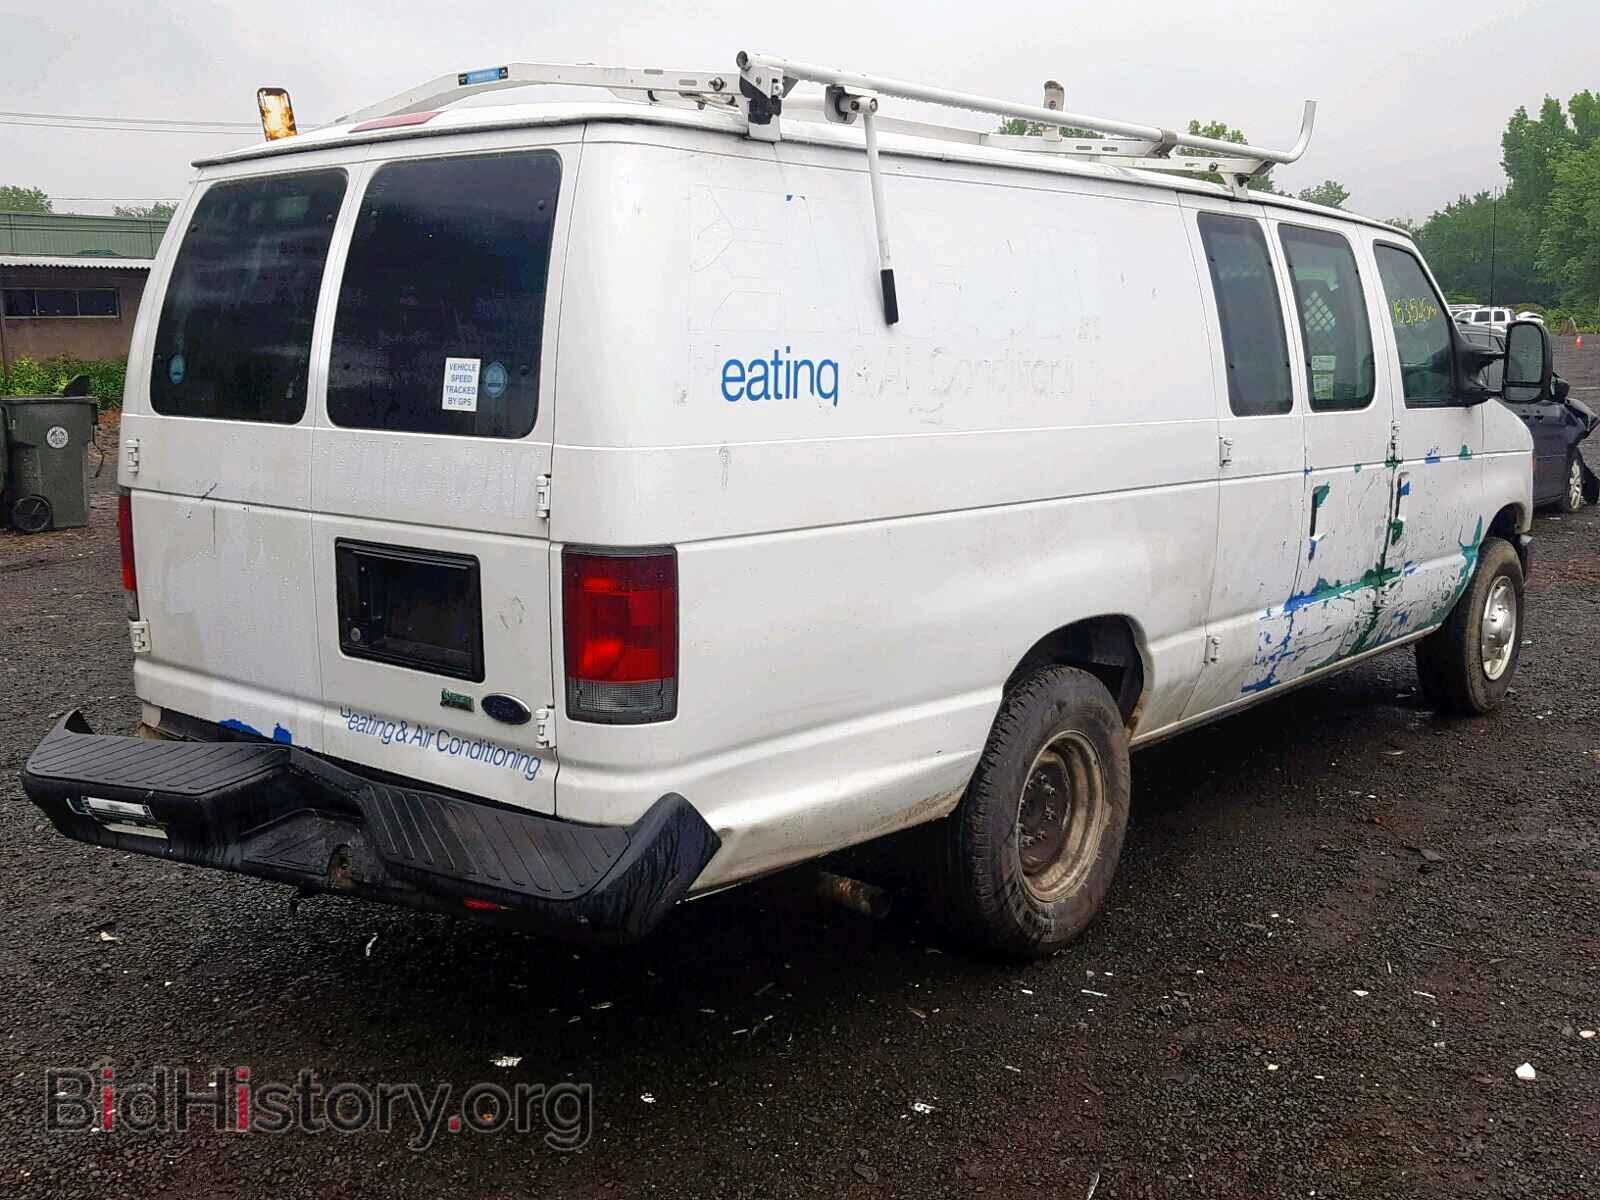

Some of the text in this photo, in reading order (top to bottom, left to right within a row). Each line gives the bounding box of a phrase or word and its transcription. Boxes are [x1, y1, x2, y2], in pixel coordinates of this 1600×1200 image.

[449, 363, 477, 372] VEHICLE
[451, 374, 473, 383] SPEED
[446, 385, 476, 395] TRACKED
[448, 397, 472, 406] BY GPS
[395, 719, 408, 744] &
[409, 724, 435, 749] Air
[436, 729, 542, 781] Conditioning
